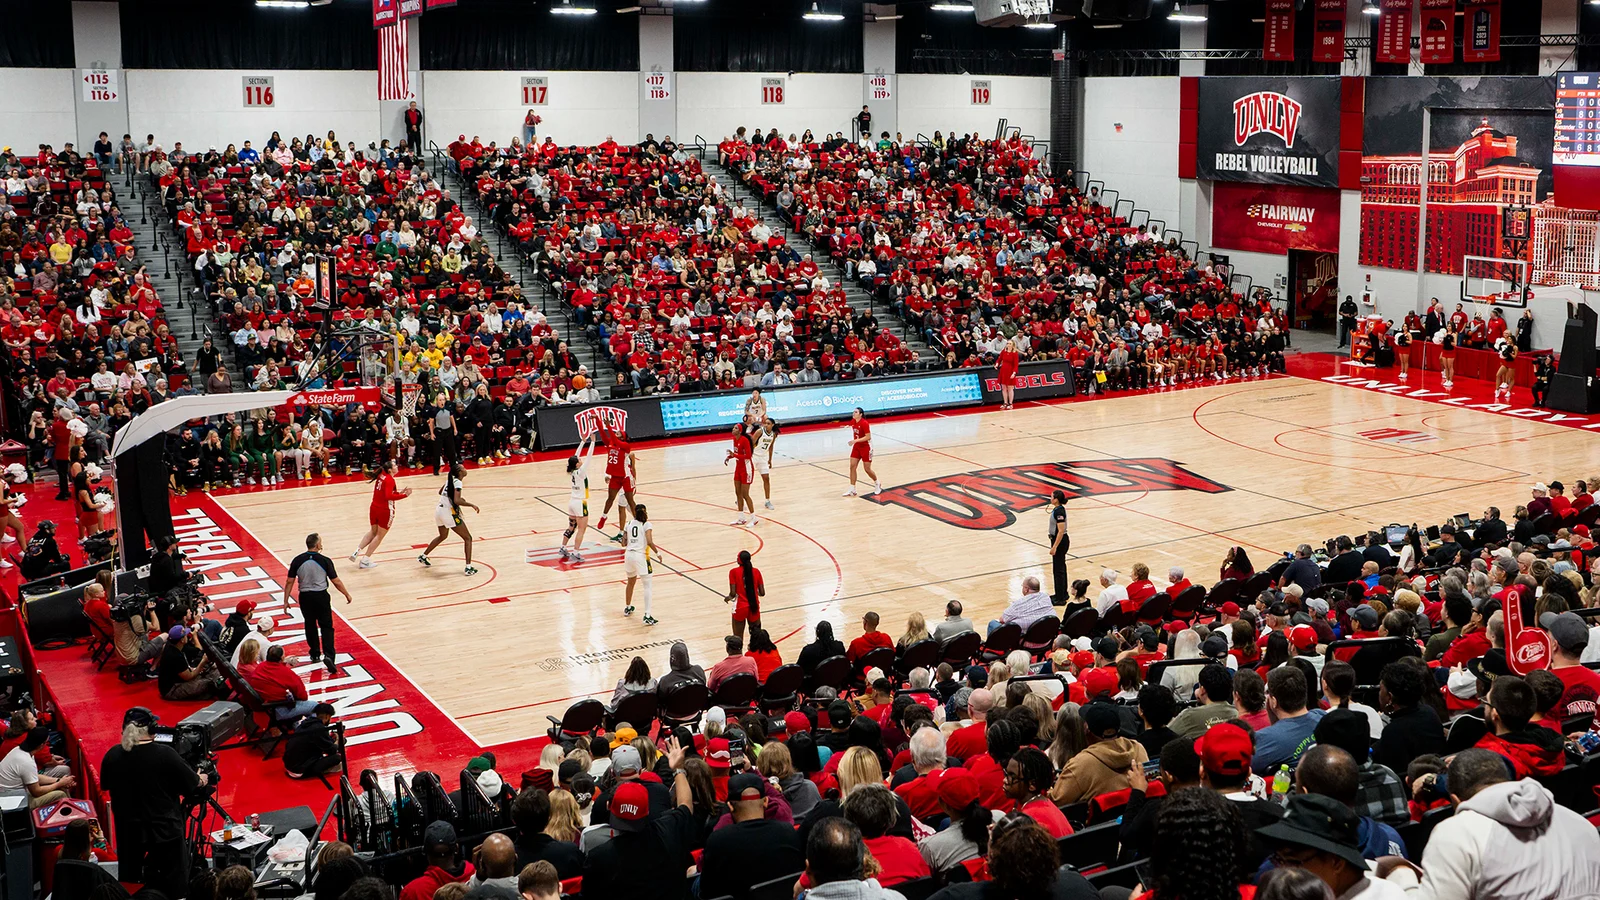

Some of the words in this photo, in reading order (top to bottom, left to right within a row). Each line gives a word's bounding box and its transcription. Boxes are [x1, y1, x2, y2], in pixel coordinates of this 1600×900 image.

[90, 74, 109, 84] 115
[651, 76, 664, 85] 117
[874, 78, 886, 86] 118
[91, 91, 110, 100] 116
[246, 86, 273, 105] 116
[523, 86, 547, 104] 117
[651, 90, 664, 99] 118
[763, 87, 783, 103] 118
[874, 91, 886, 99] 119
[972, 88, 990, 104] 119
[1233, 92, 1302, 148] UNLV
[1216, 153, 1248, 172] REBEL
[1250, 154, 1318, 176] VOLLEYBALL
[1262, 204, 1315, 223] FAIRWAY
[986, 372, 1066, 392] RBELS
[796, 399, 822, 408] Acesso
[832, 395, 864, 406] Biologics
[1321, 374, 1449, 397] UNLV
[1440, 397, 1588, 422] LADY
[608, 456, 618, 464] 25
[860, 457, 1236, 530] UNLV
[632, 526, 638, 538] 0
[569, 638, 684, 660] Intermountain
[576, 654, 630, 667] Health
[291, 652, 425, 747] UNLV
[620, 804, 639, 816] UNLV
